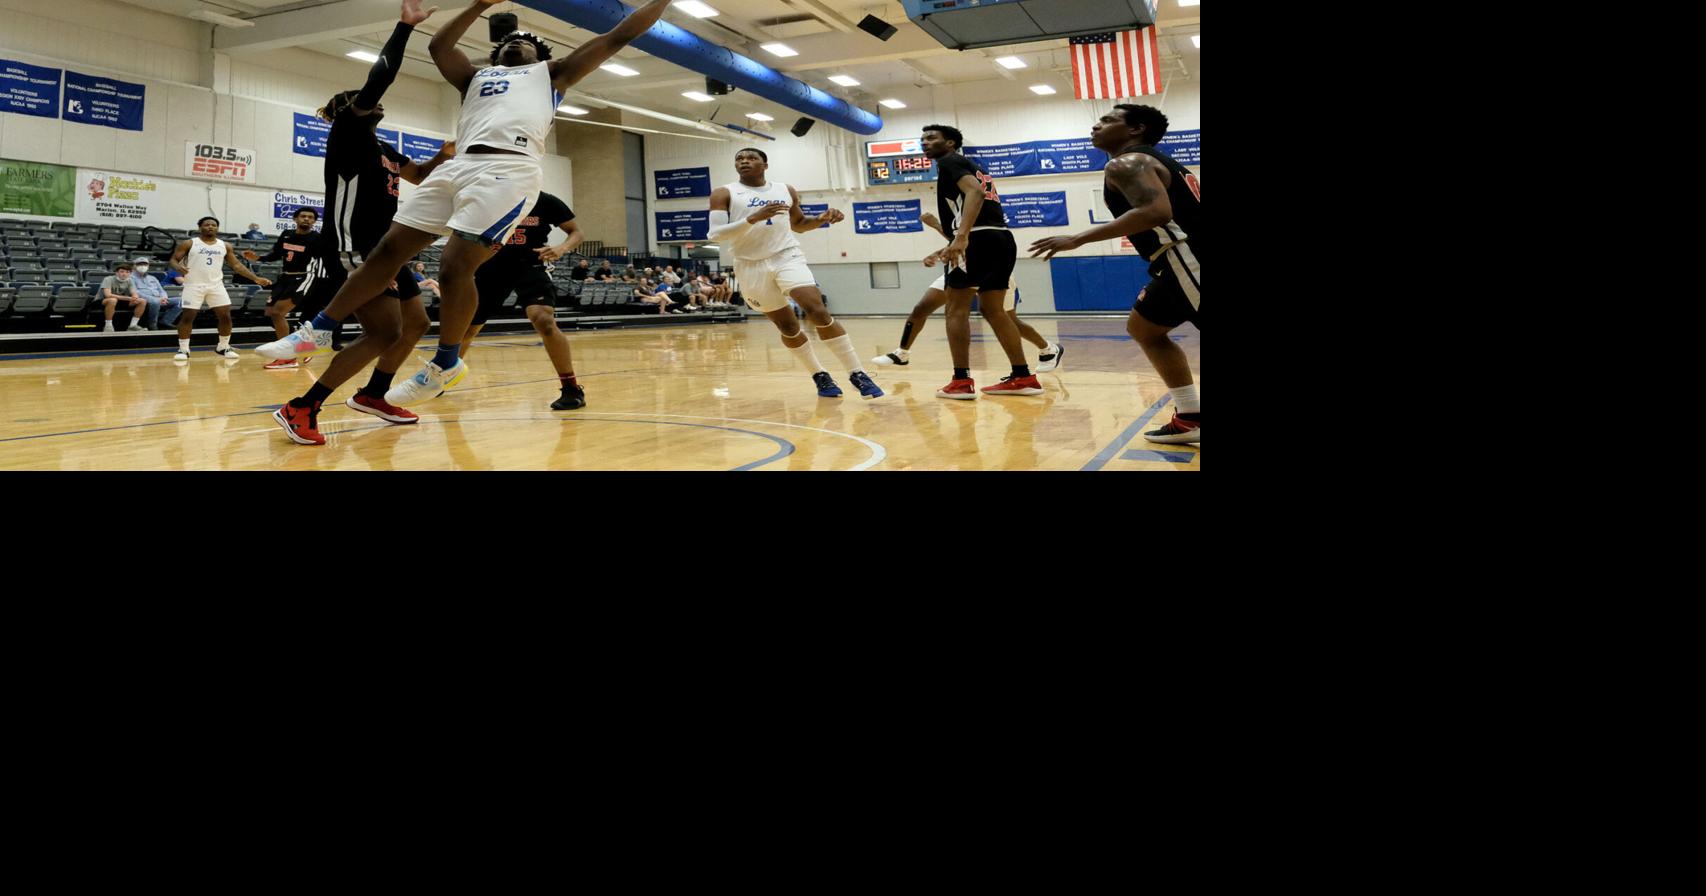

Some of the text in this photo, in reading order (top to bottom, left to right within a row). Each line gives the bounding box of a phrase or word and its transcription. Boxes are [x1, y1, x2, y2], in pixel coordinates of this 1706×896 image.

[480, 80, 510, 97] 23
[91, 100, 120, 108] VOLUNTEERS
[195, 144, 237, 161] 103.5
[192, 157, 247, 177] ESPN
[6, 167, 54, 180] FARMERS
[275, 192, 324, 206] Chris Street
[747, 197, 786, 208] Logan
[198, 246, 221, 256] Logan
[286, 251, 294, 261] 3
[206, 257, 213, 265] 3
